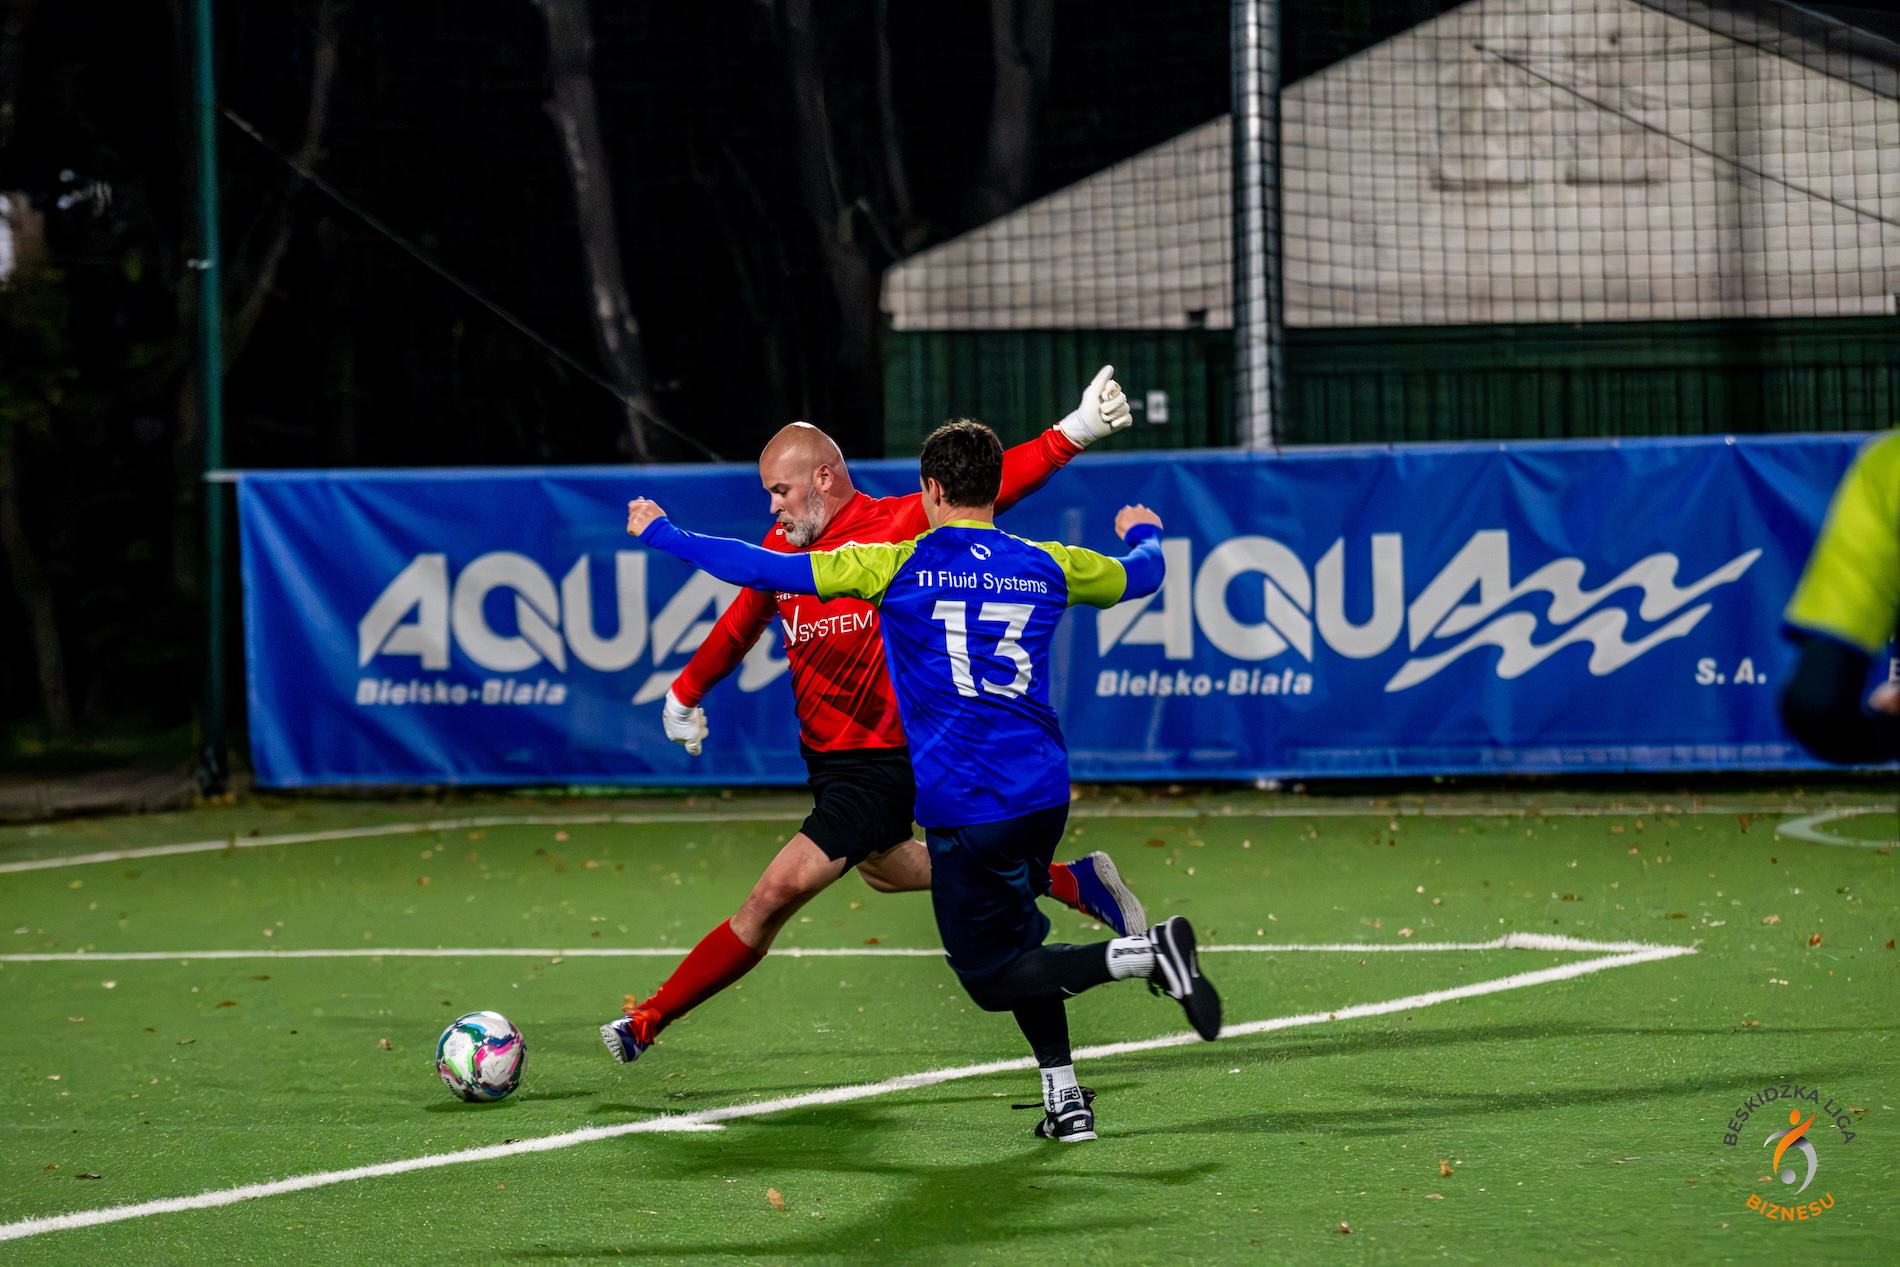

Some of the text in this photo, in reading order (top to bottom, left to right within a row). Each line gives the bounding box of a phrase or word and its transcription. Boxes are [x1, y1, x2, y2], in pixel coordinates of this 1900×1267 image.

[358, 550, 744, 673] AQUA
[916, 570, 1048, 594] TI Fluid Systems
[1096, 529, 1510, 664] AQUA
[931, 600, 1035, 699] 13
